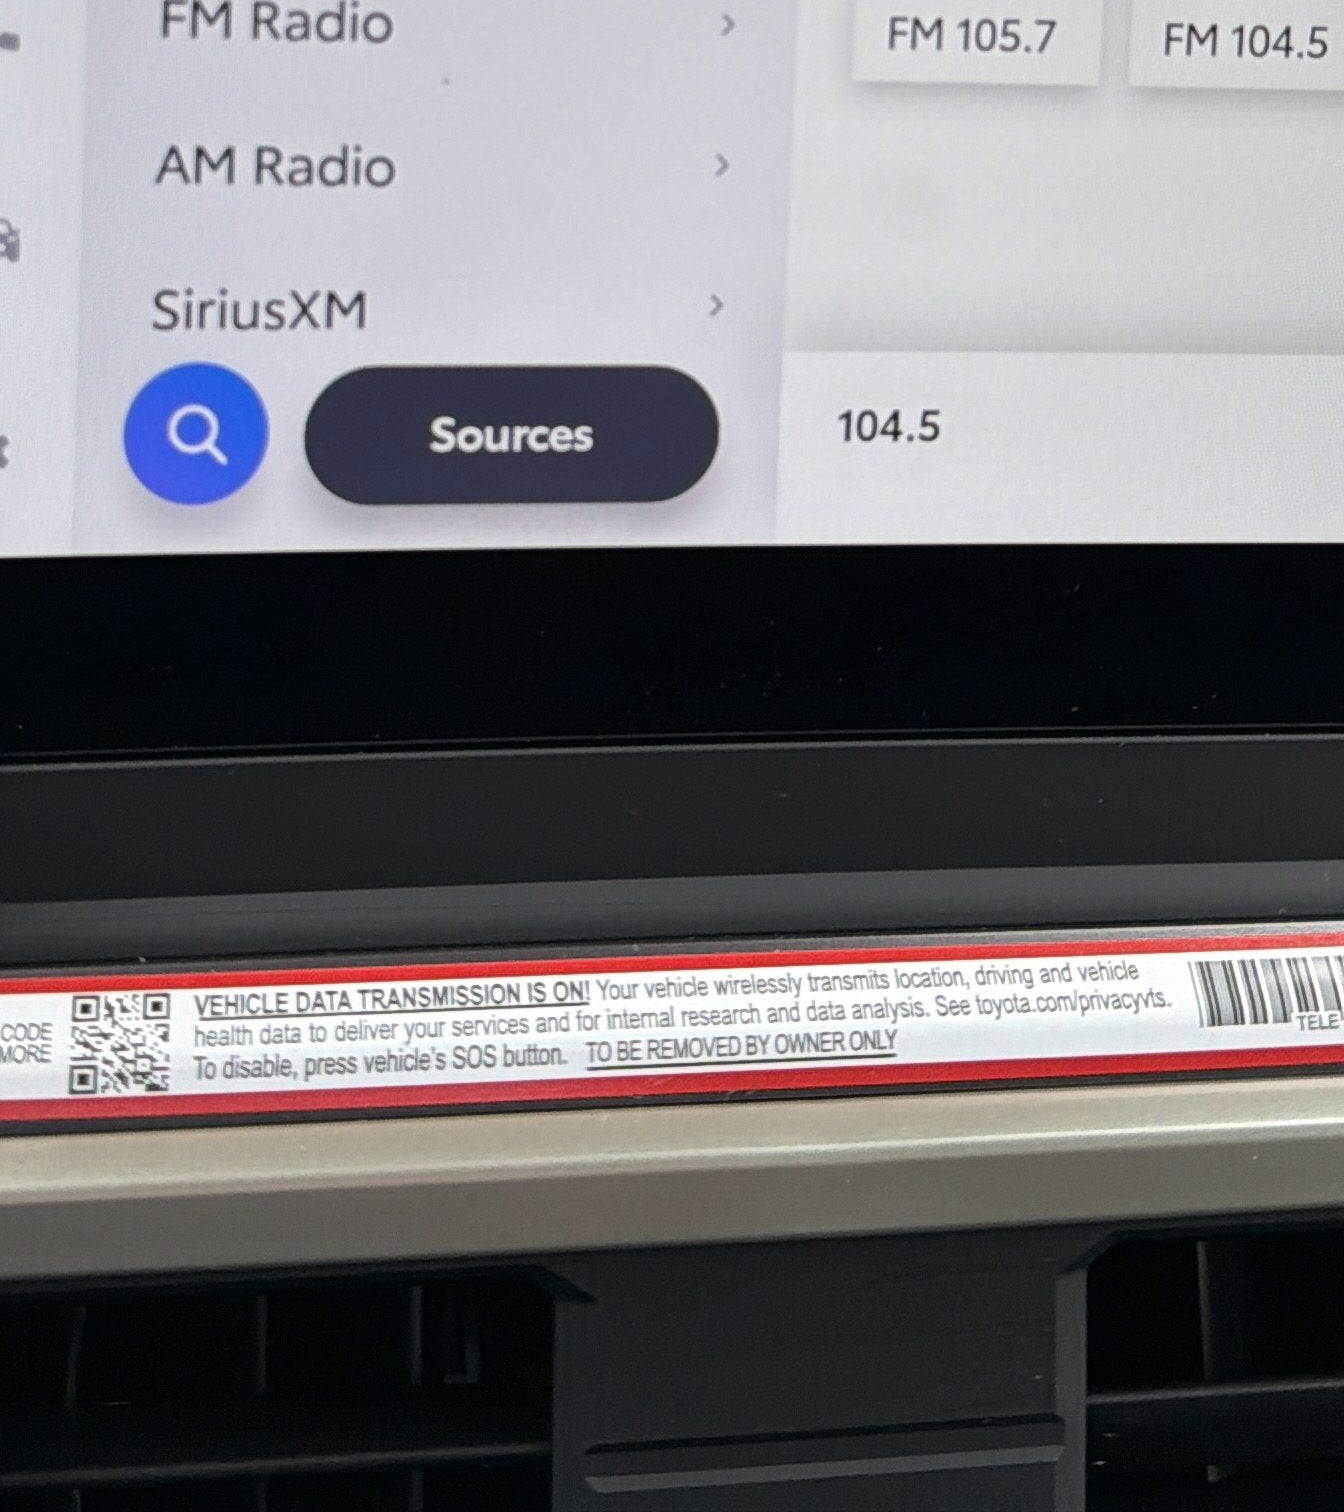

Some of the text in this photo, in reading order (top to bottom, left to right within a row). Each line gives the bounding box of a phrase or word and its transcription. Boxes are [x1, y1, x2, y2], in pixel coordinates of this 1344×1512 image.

[251, 0, 395, 44] Radio
[887, 16, 1057, 55] FM 105.7
[1164, 22, 1329, 60] FM 104.5
[155, 144, 397, 188] AM Radio
[151, 287, 368, 331] SiriusXM
[429, 415, 595, 455] Sources
[837, 408, 942, 445] 104.5
[193, 960, 1140, 1017] VEHICLE DATA TRANSMISSION IS ON! Your vehicle wirelessly transmits location, driving and vehicle
[0, 1022, 54, 1043] CODE
[193, 987, 1173, 1048] health data to deliver your services and for internal research and data analysis. See toyota.com/privacyvts.
[1296, 1012, 1341, 1031] TELE
[193, 1028, 898, 1083] To disable, press vehicle's SOS button. TO BE REMOVED BY OWNER ONLY
